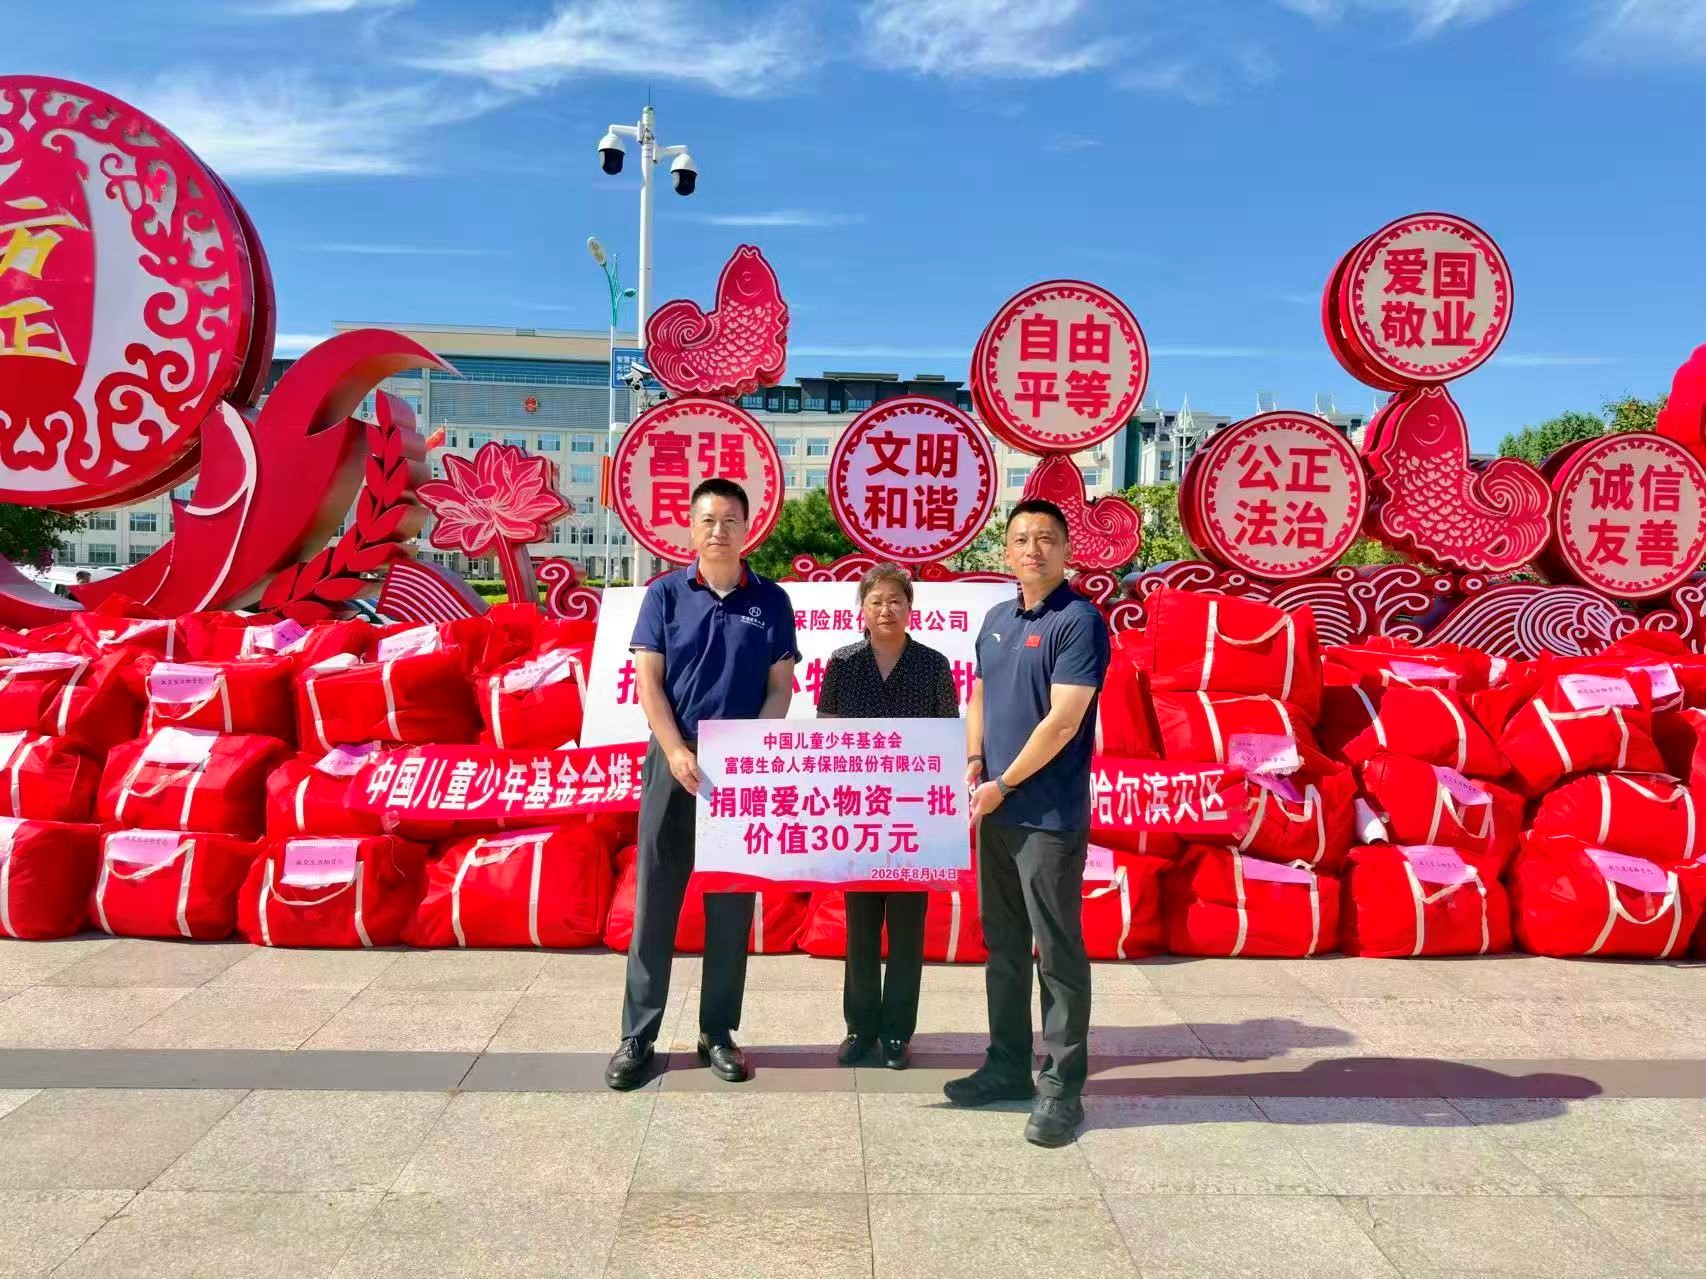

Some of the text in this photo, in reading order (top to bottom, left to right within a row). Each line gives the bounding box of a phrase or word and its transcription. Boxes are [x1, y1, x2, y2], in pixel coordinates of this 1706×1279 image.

[1383, 248, 1477, 299] 爱国
[1020, 313, 1111, 364] 自由
[1380, 300, 1477, 349] 敬业
[1014, 369, 1111, 419] 平等
[648, 431, 747, 480] 富强
[866, 431, 958, 478] 文明
[1238, 444, 1332, 492] 公正
[650, 482, 691, 527] 民
[865, 485, 958, 531] 和谐
[1589, 461, 1684, 512] 诚信
[1234, 499, 1328, 549] 法治
[1587, 518, 1679, 567] 友善
[725, 755, 941, 774] 富德生命人寿保险股份有限公司
[763, 732, 903, 751] 中国儿童少年基金会
[709, 784, 957, 818] 捐赠爱心物资一批
[1089, 769, 1228, 825] 哈尔滨灾区
[743, 822, 919, 855] 价值30万元
[871, 867, 957, 880] 2026年8月14日
